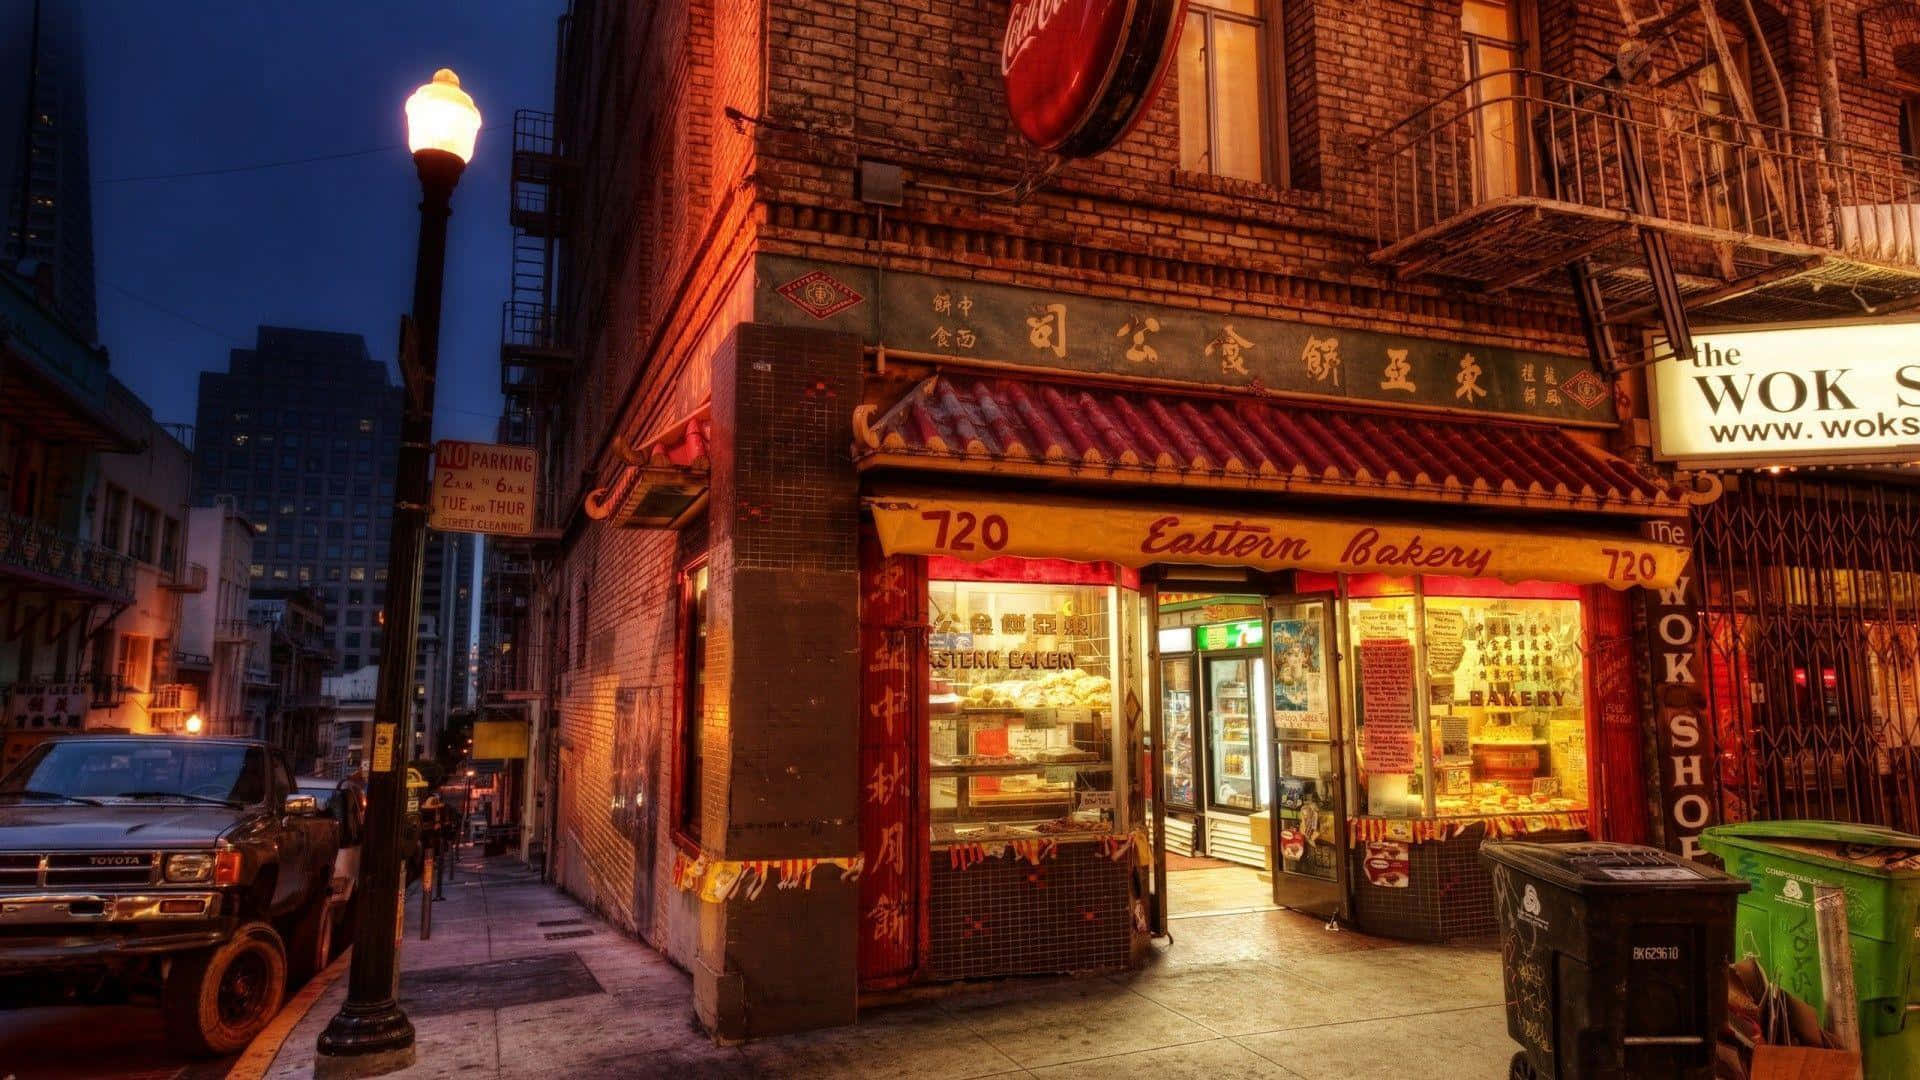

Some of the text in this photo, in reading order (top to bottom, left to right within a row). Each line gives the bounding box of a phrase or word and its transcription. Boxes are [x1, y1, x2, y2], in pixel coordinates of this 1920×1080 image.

[1693, 342, 1741, 367] the
[1692, 368, 1859, 416] WOK
[439, 443, 532, 473] NO PARKING
[441, 496, 525, 516] TUE AND THUR
[440, 516, 524, 533] STREET CLEANING
[921, 510, 1009, 551] 720
[1648, 520, 1685, 544] The
[1140, 516, 1492, 577] Eastern Bakery
[1602, 548, 1657, 581] 720
[1008, 650, 1079, 670] BAKERY
[1470, 690, 1565, 707] BAKERY
[90, 856, 139, 865] TOYOTA
